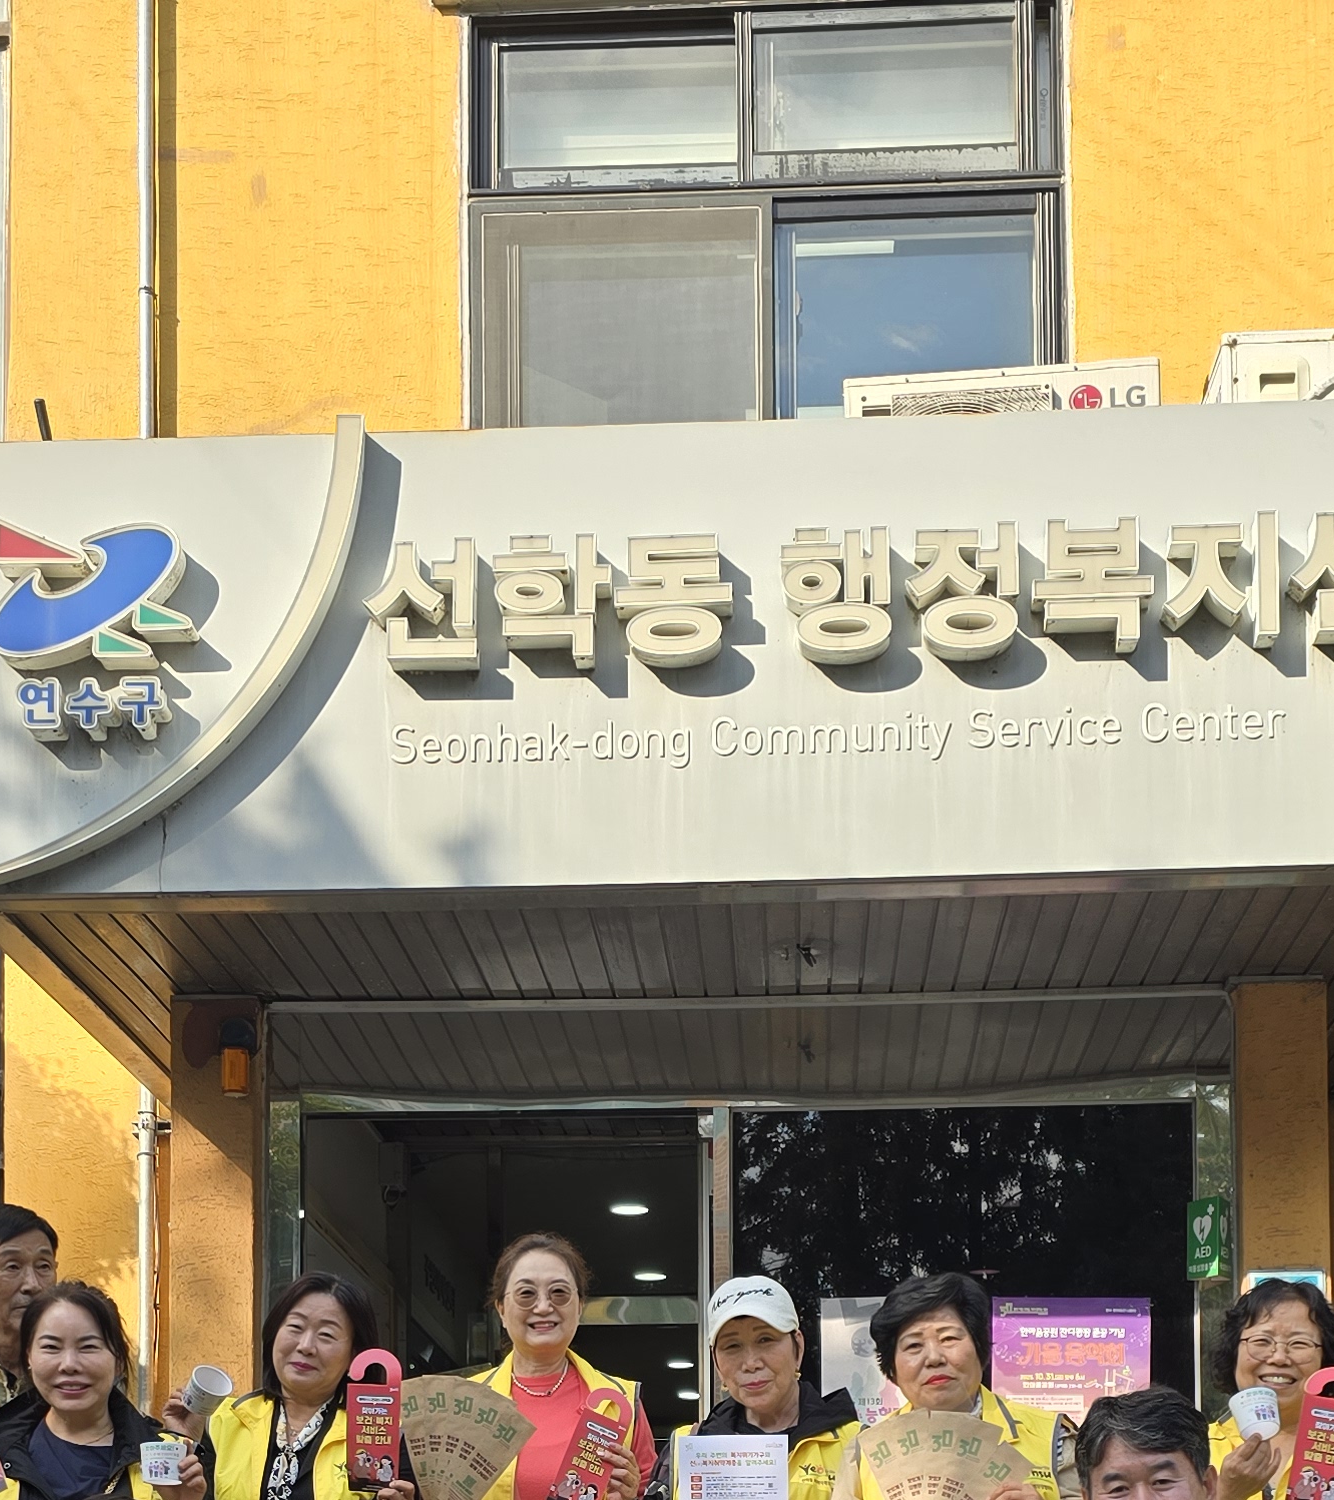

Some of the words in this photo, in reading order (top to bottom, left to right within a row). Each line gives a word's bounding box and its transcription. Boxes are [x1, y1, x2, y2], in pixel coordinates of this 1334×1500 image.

[1109, 385, 1146, 408] LG
[362, 532, 734, 671] 선학동
[17, 675, 167, 735] 연수구
[389, 719, 694, 767] Seonhak-dong
[708, 711, 954, 762] Community
[966, 707, 1123, 750] Service
[1139, 702, 1287, 744] Center
[1194, 1245, 1212, 1260] AED
[1018, 1341, 1064, 1366] 가을
[1064, 1341, 1126, 1367] 음악회
[858, 1398, 883, 1406] 제13회
